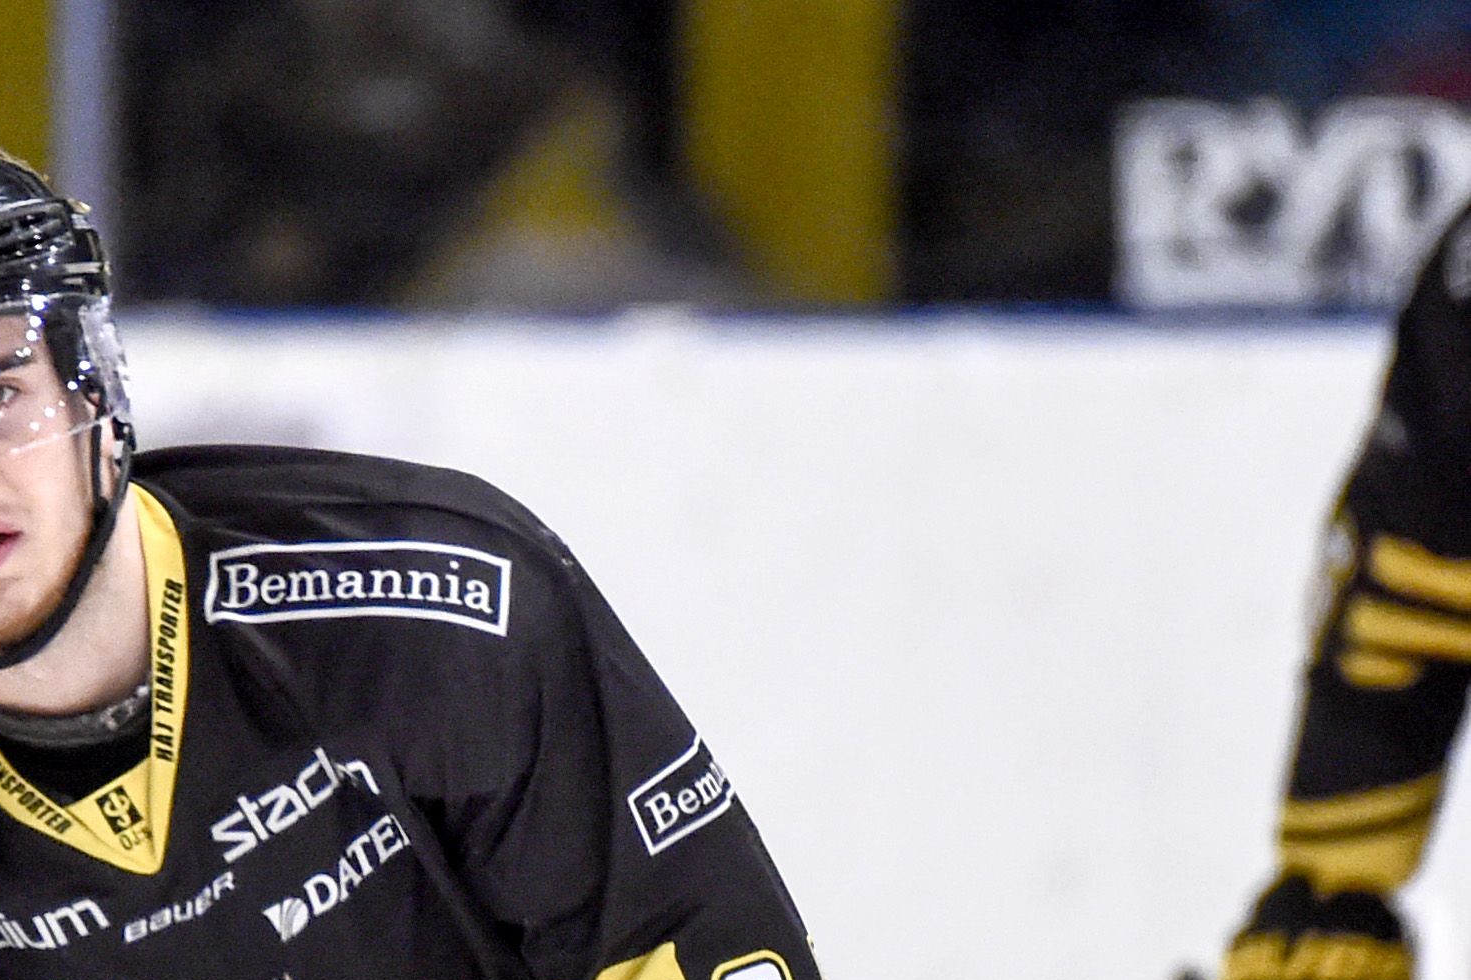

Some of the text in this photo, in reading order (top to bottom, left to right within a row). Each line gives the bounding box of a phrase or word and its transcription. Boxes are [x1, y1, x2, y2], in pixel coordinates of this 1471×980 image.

[222, 560, 495, 614] Bemannia
[155, 578, 184, 714] TRANSPORTER
[644, 762, 726, 834] Bem
[303, 813, 411, 917] DATE
